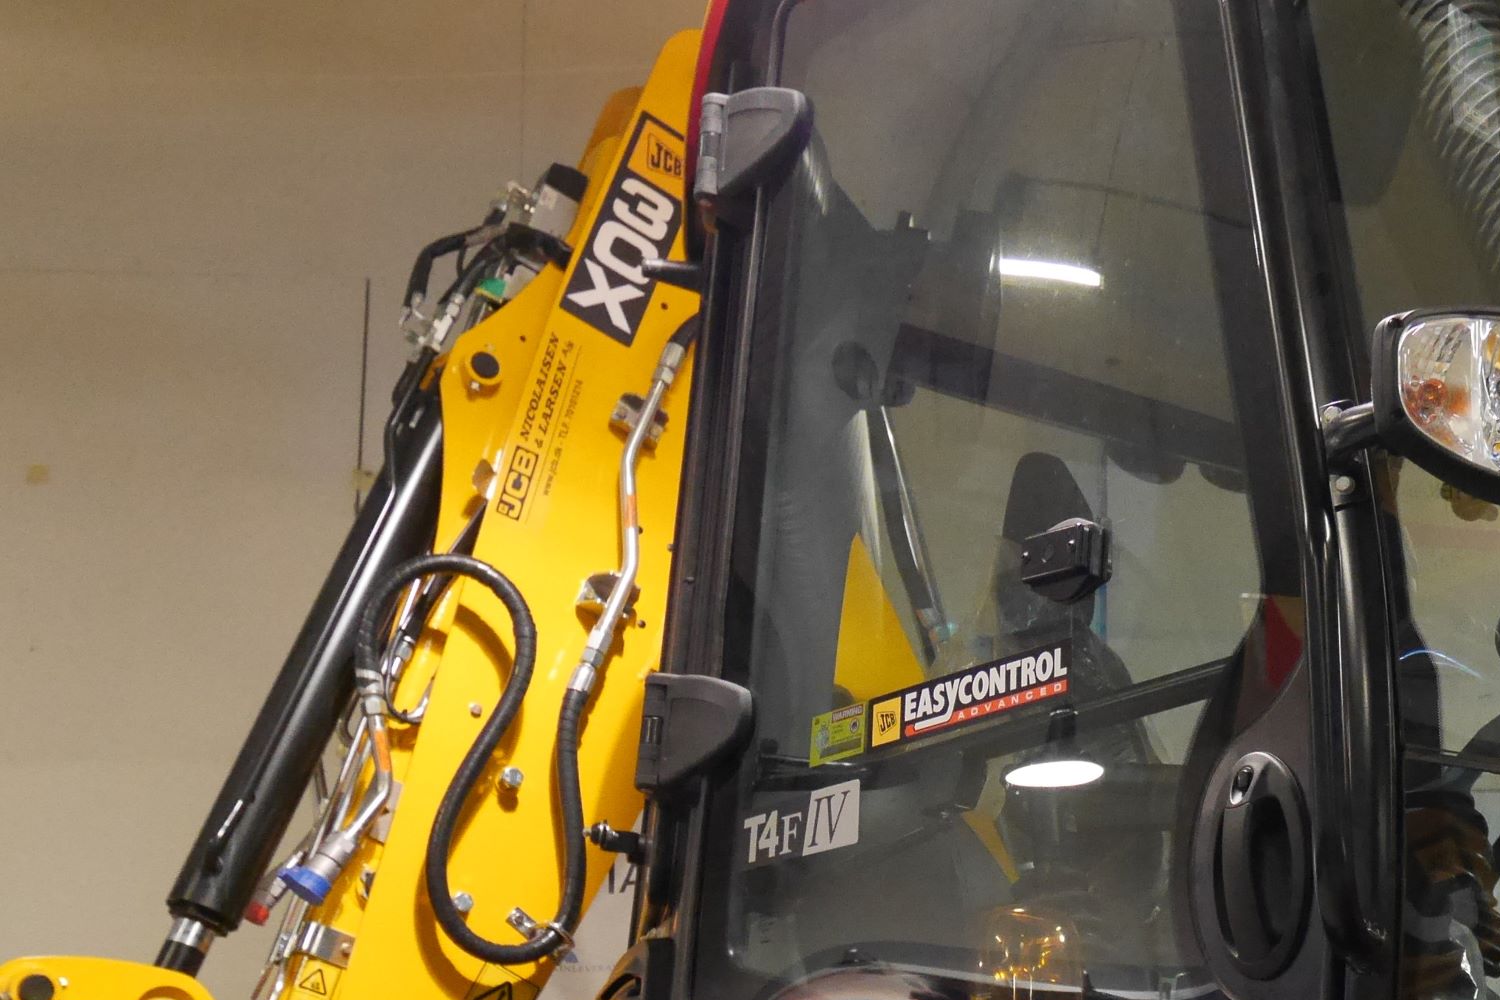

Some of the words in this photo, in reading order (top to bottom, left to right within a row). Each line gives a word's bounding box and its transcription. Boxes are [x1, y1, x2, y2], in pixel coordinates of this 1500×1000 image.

[651, 142, 681, 177] JCB
[520, 332, 559, 442] NICOLAISEN
[538, 360, 567, 436] LARSEN
[498, 446, 538, 520] JCB
[880, 713, 896, 733] JCB
[904, 648, 1067, 729] EASYCONTROL
[957, 682, 1063, 721] ADVANCED
